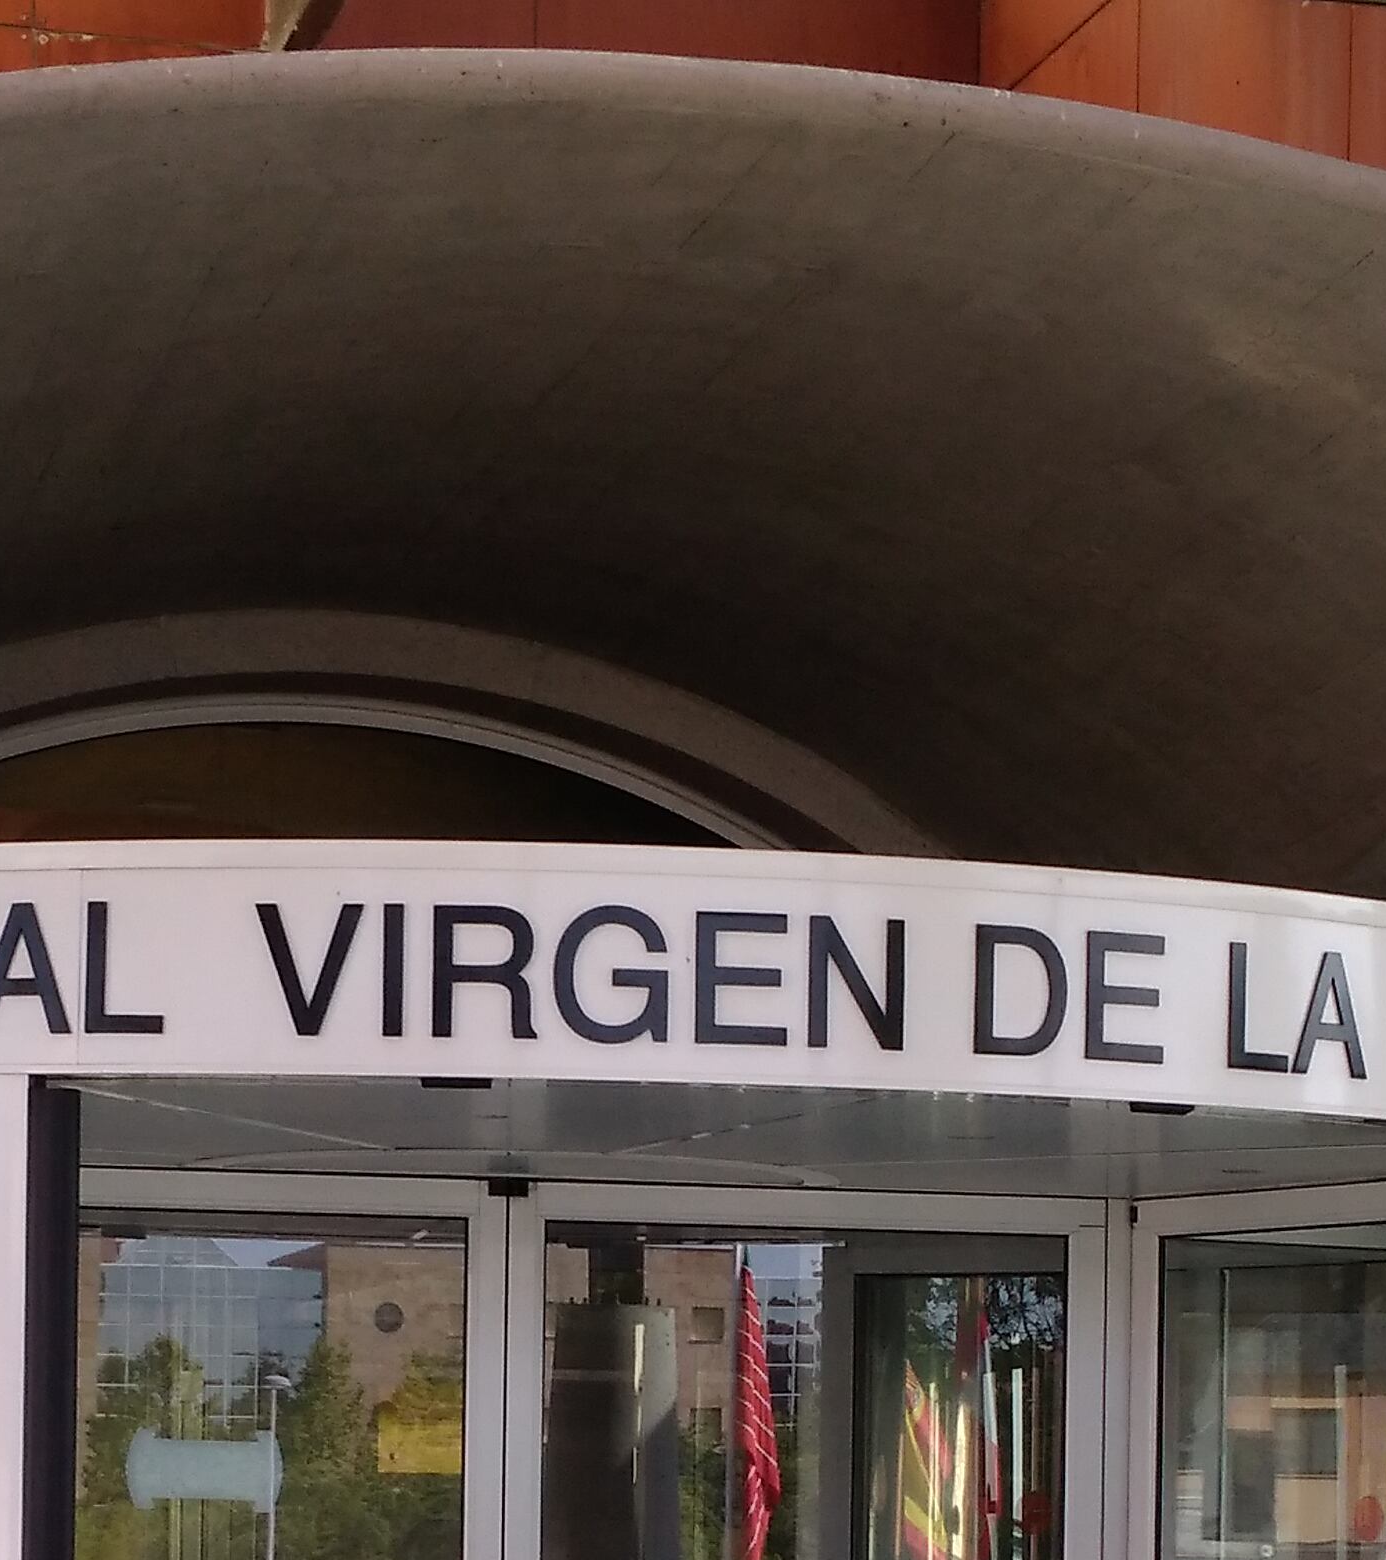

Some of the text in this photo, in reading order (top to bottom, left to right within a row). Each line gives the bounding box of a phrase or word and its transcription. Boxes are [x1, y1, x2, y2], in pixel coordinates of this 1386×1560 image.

[253, 901, 907, 1052] VIRGEN
[971, 922, 1167, 1066] DE
[1225, 936, 1369, 1081] LA
